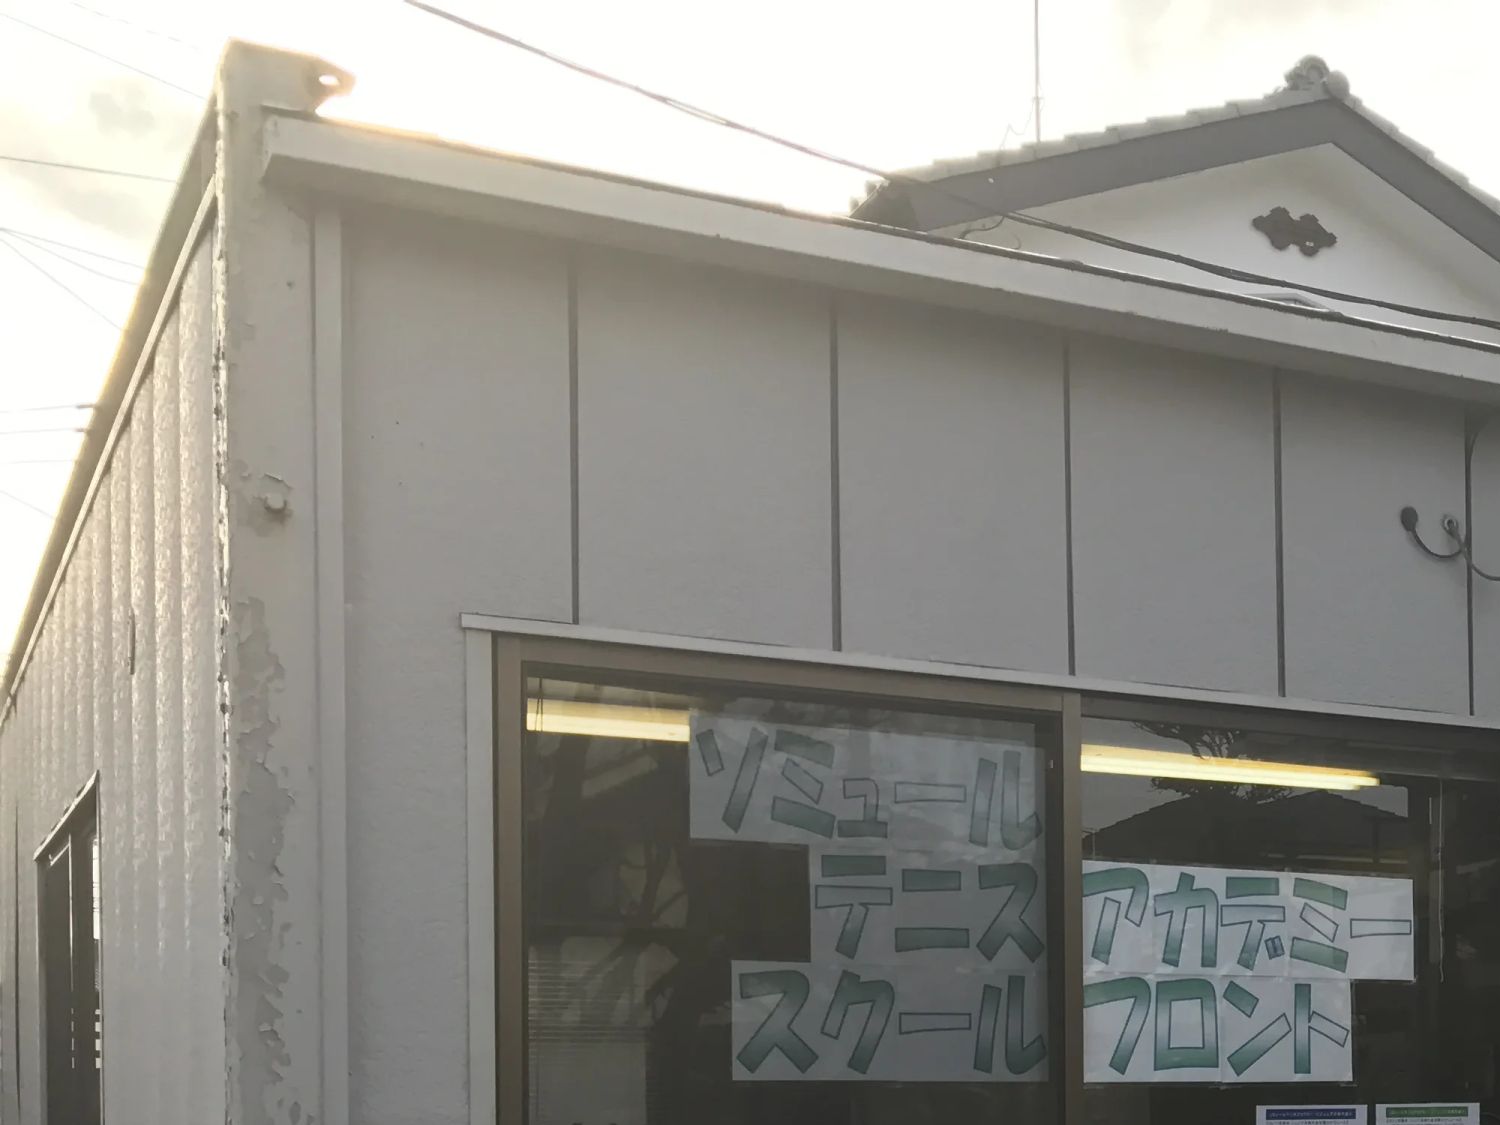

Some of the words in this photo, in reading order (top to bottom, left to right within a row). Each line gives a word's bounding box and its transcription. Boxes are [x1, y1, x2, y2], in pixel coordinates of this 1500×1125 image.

[697, 727, 1042, 850] ソミュール
[814, 854, 1045, 963] テニス
[1082, 866, 1412, 973] アカデミー
[736, 969, 1048, 1075] スクール
[1083, 976, 1350, 1077] フロント
